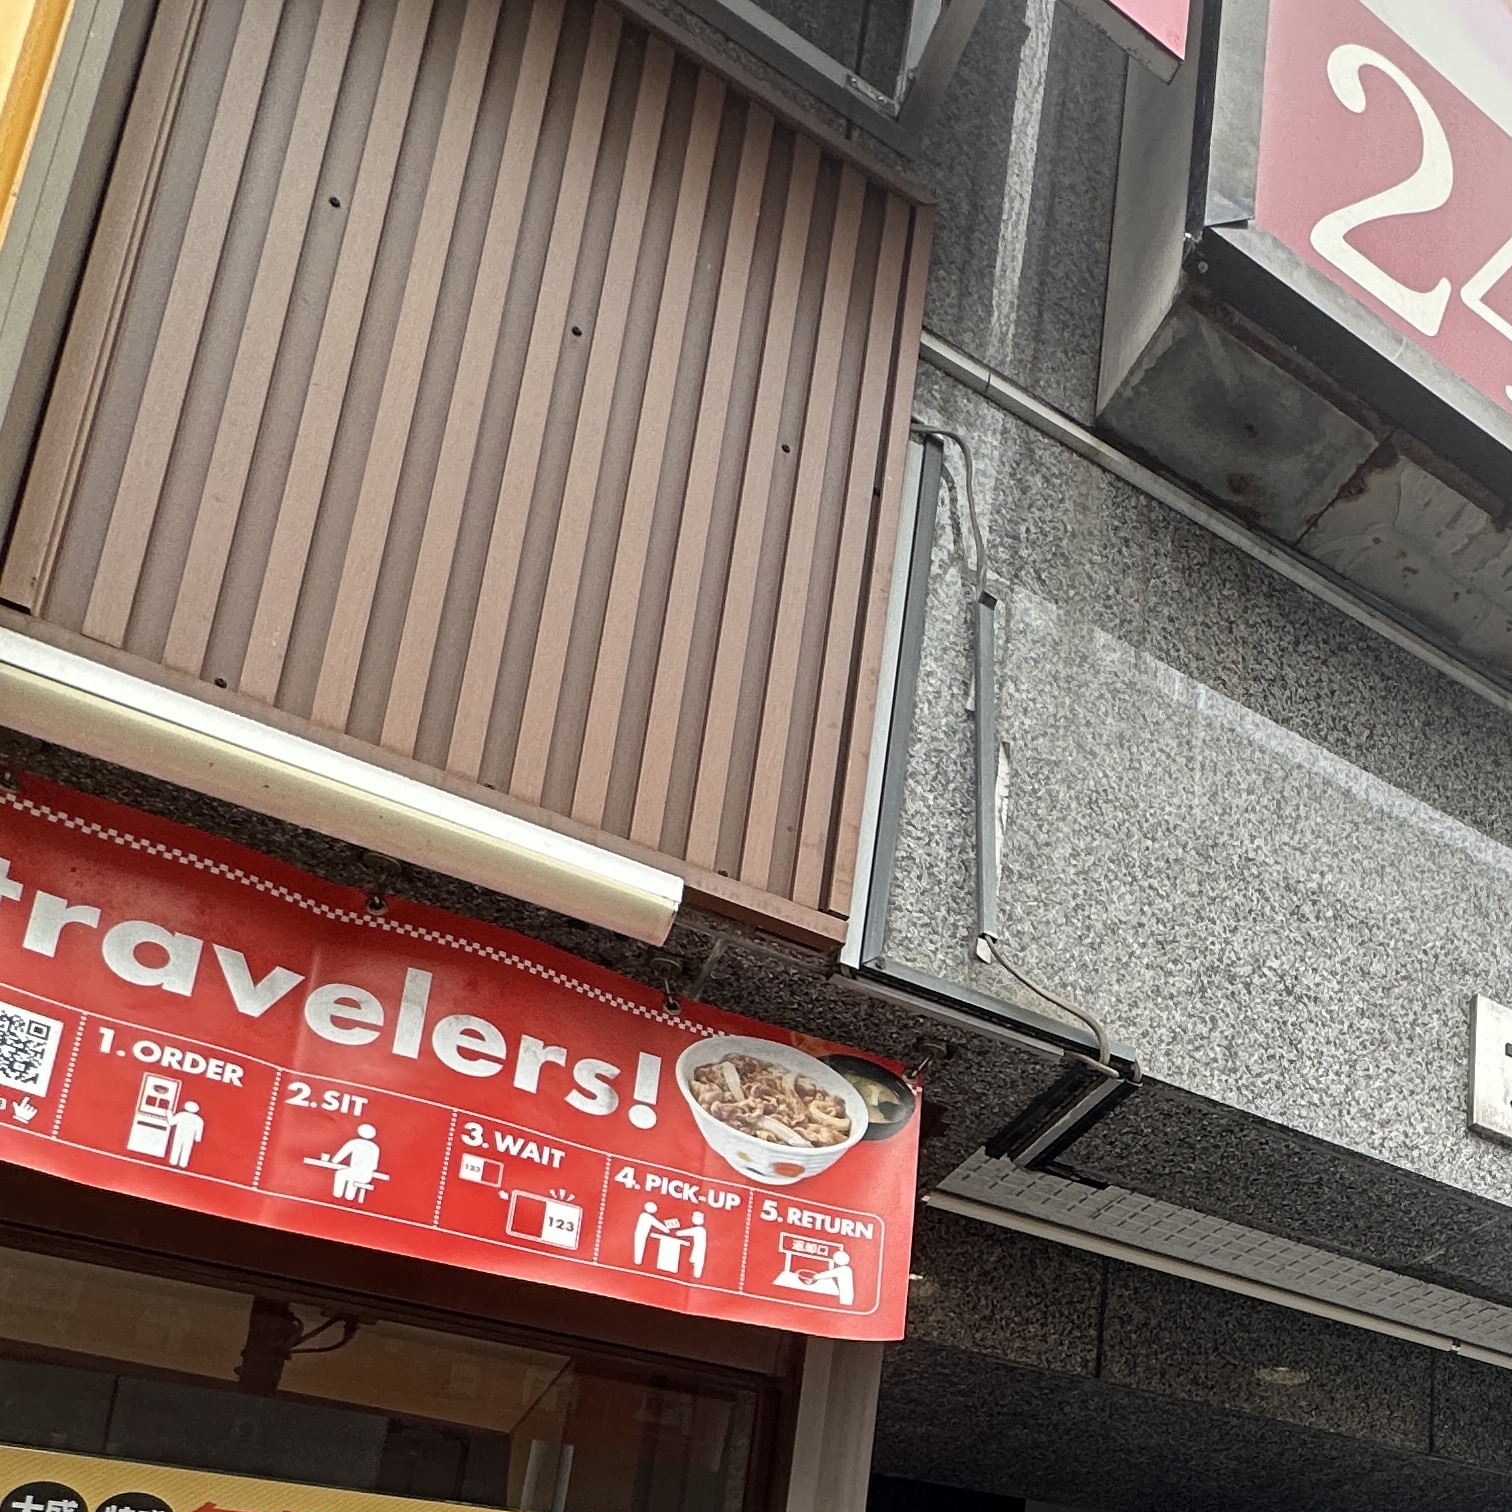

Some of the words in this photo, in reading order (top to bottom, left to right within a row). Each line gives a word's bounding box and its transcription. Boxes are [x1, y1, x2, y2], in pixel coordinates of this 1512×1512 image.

[99, 1026, 128, 1057] 1.
[132, 1039, 244, 1089] ORDER
[286, 1081, 319, 1113] 2.
[321, 1089, 370, 1118] SIT
[461, 1121, 490, 1151] 3.
[494, 1131, 567, 1170] WAIT
[614, 1166, 641, 1191] 4.
[645, 1175, 741, 1212] PICK-UP
[547, 1216, 575, 1233] 123
[759, 1200, 784, 1223] 5.
[788, 1208, 875, 1241] RETURN
